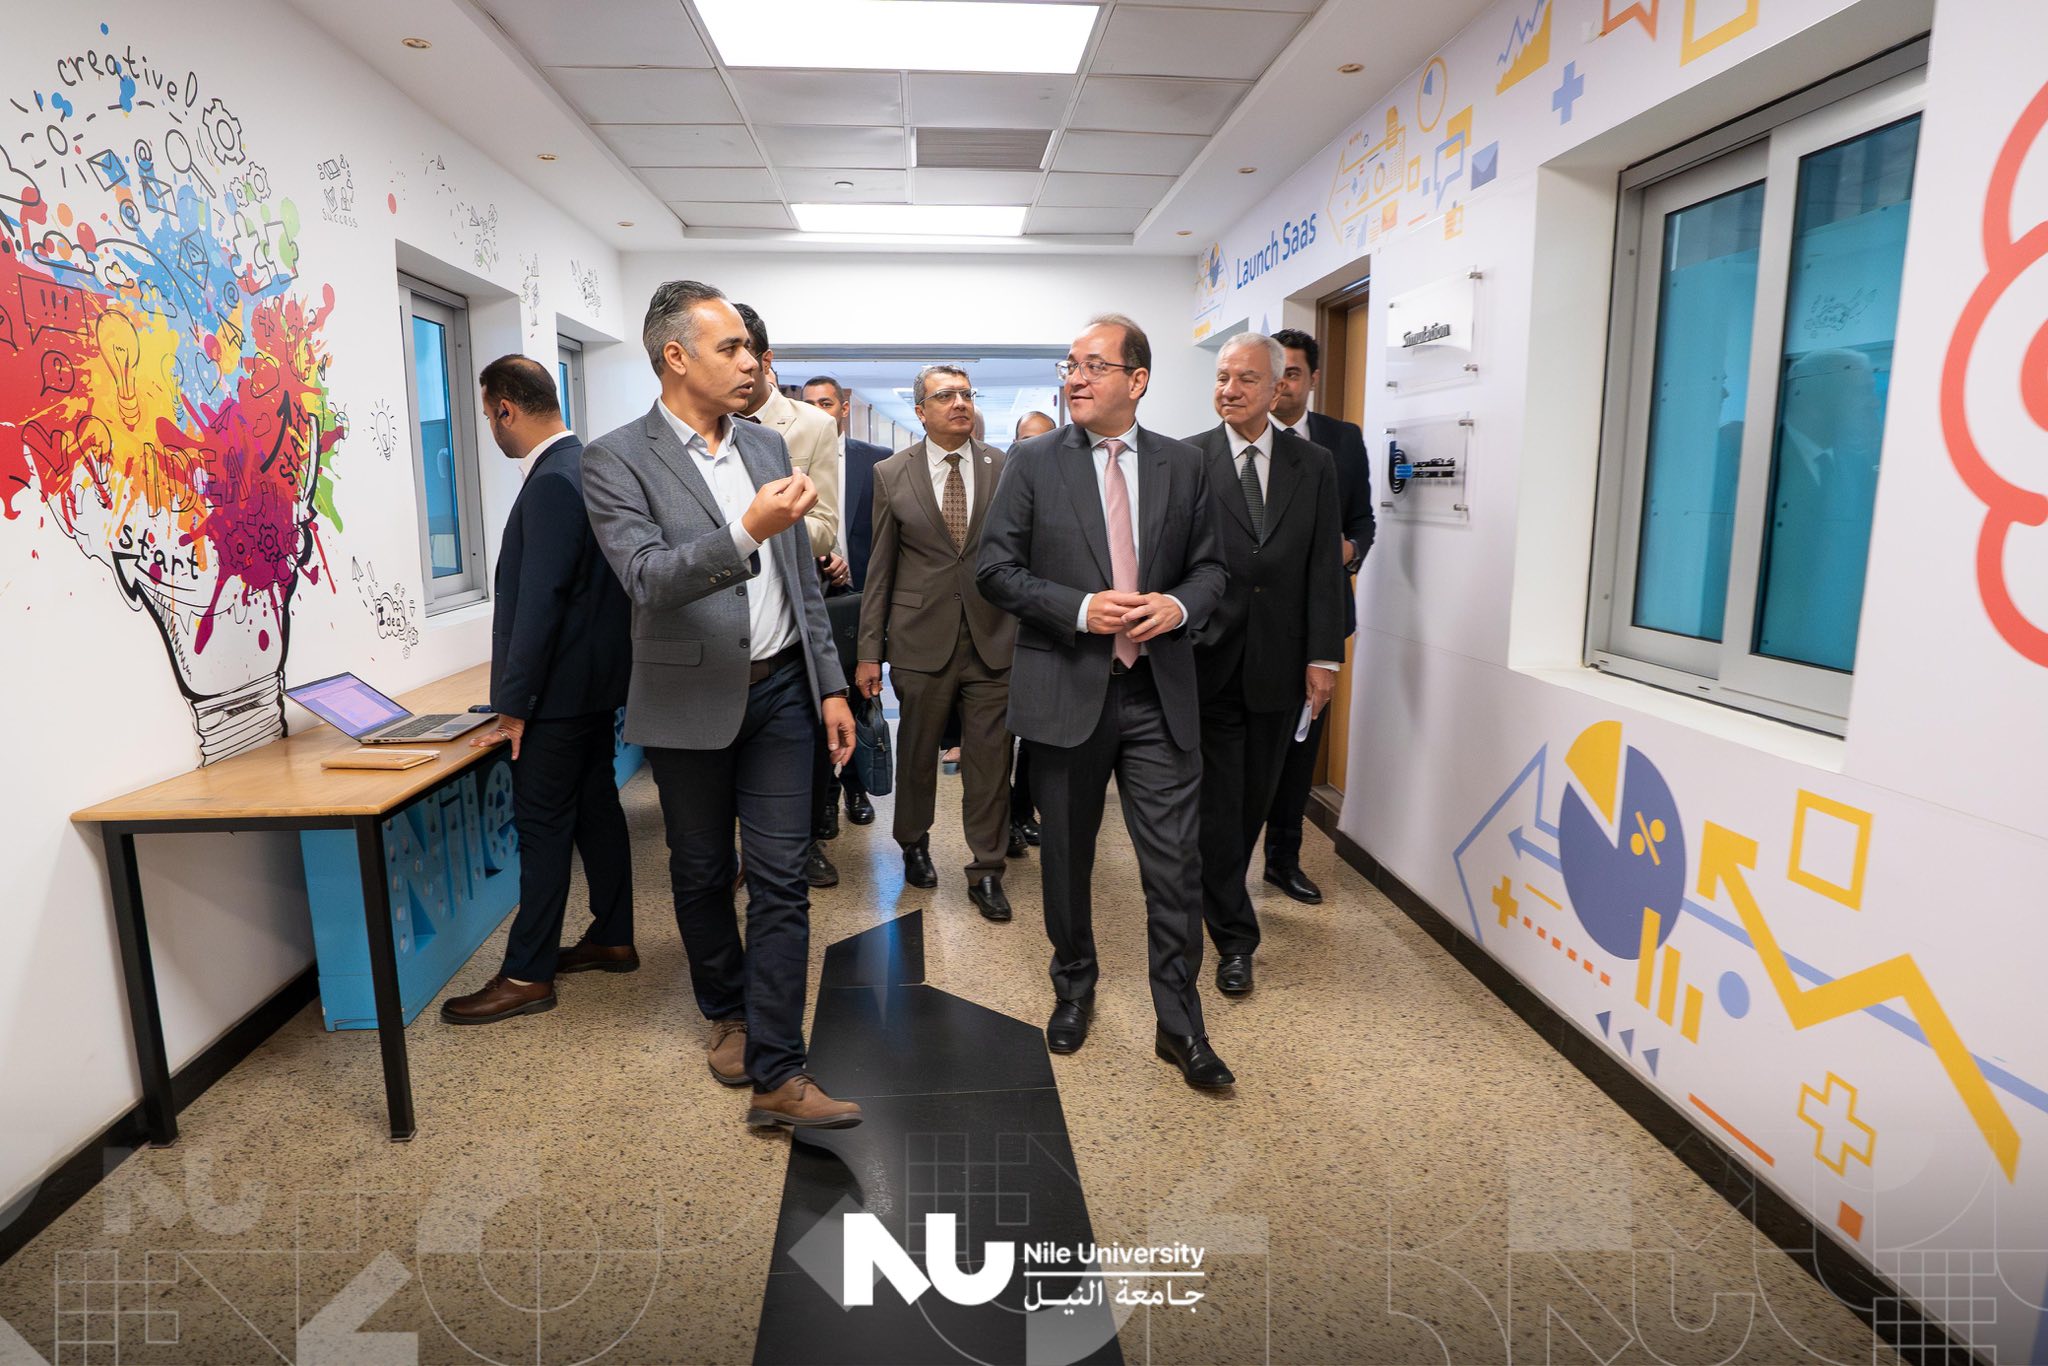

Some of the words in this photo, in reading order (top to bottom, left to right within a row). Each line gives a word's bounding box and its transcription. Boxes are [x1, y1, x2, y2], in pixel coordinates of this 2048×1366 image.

[57, 45, 198, 116] creative!
[1236, 230, 1279, 290] Launch
[1282, 213, 1317, 261] Saas
[143, 442, 249, 518] IDEA
